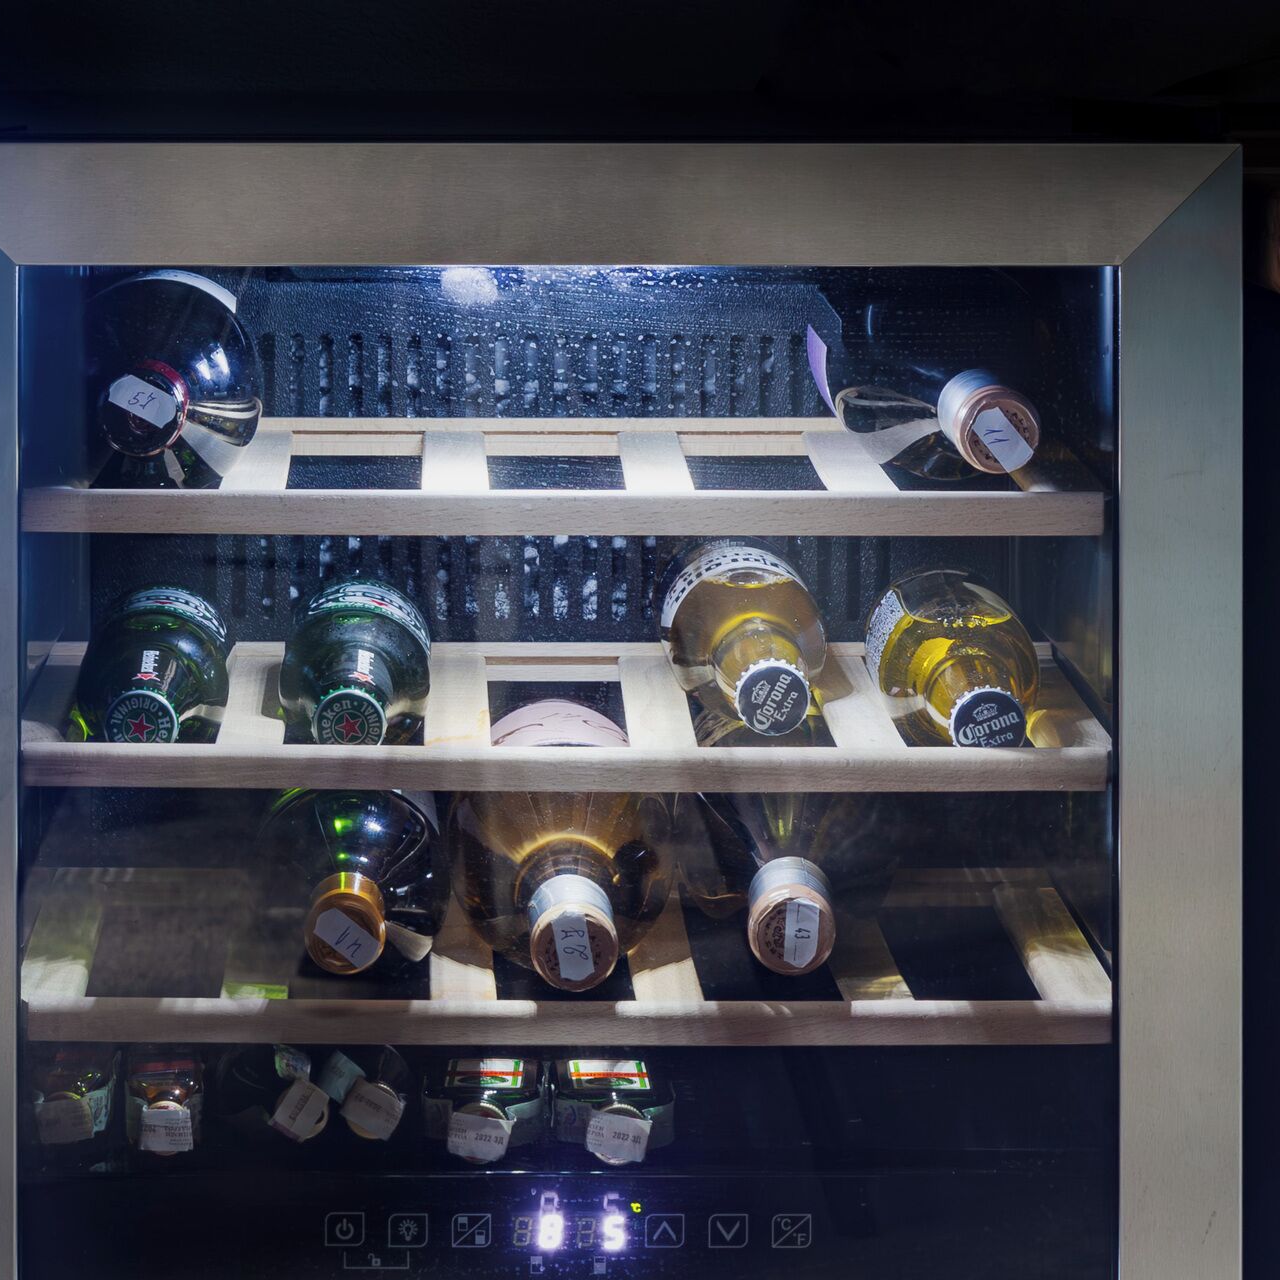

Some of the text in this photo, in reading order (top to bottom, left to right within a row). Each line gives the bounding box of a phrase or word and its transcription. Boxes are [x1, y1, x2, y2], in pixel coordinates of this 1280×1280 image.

[110, 697, 159, 725] ORIGINAL
[753, 673, 792, 730] Corona
[773, 691, 799, 722] Extra
[958, 711, 1020, 745] Corona
[980, 732, 1014, 747] Extra
